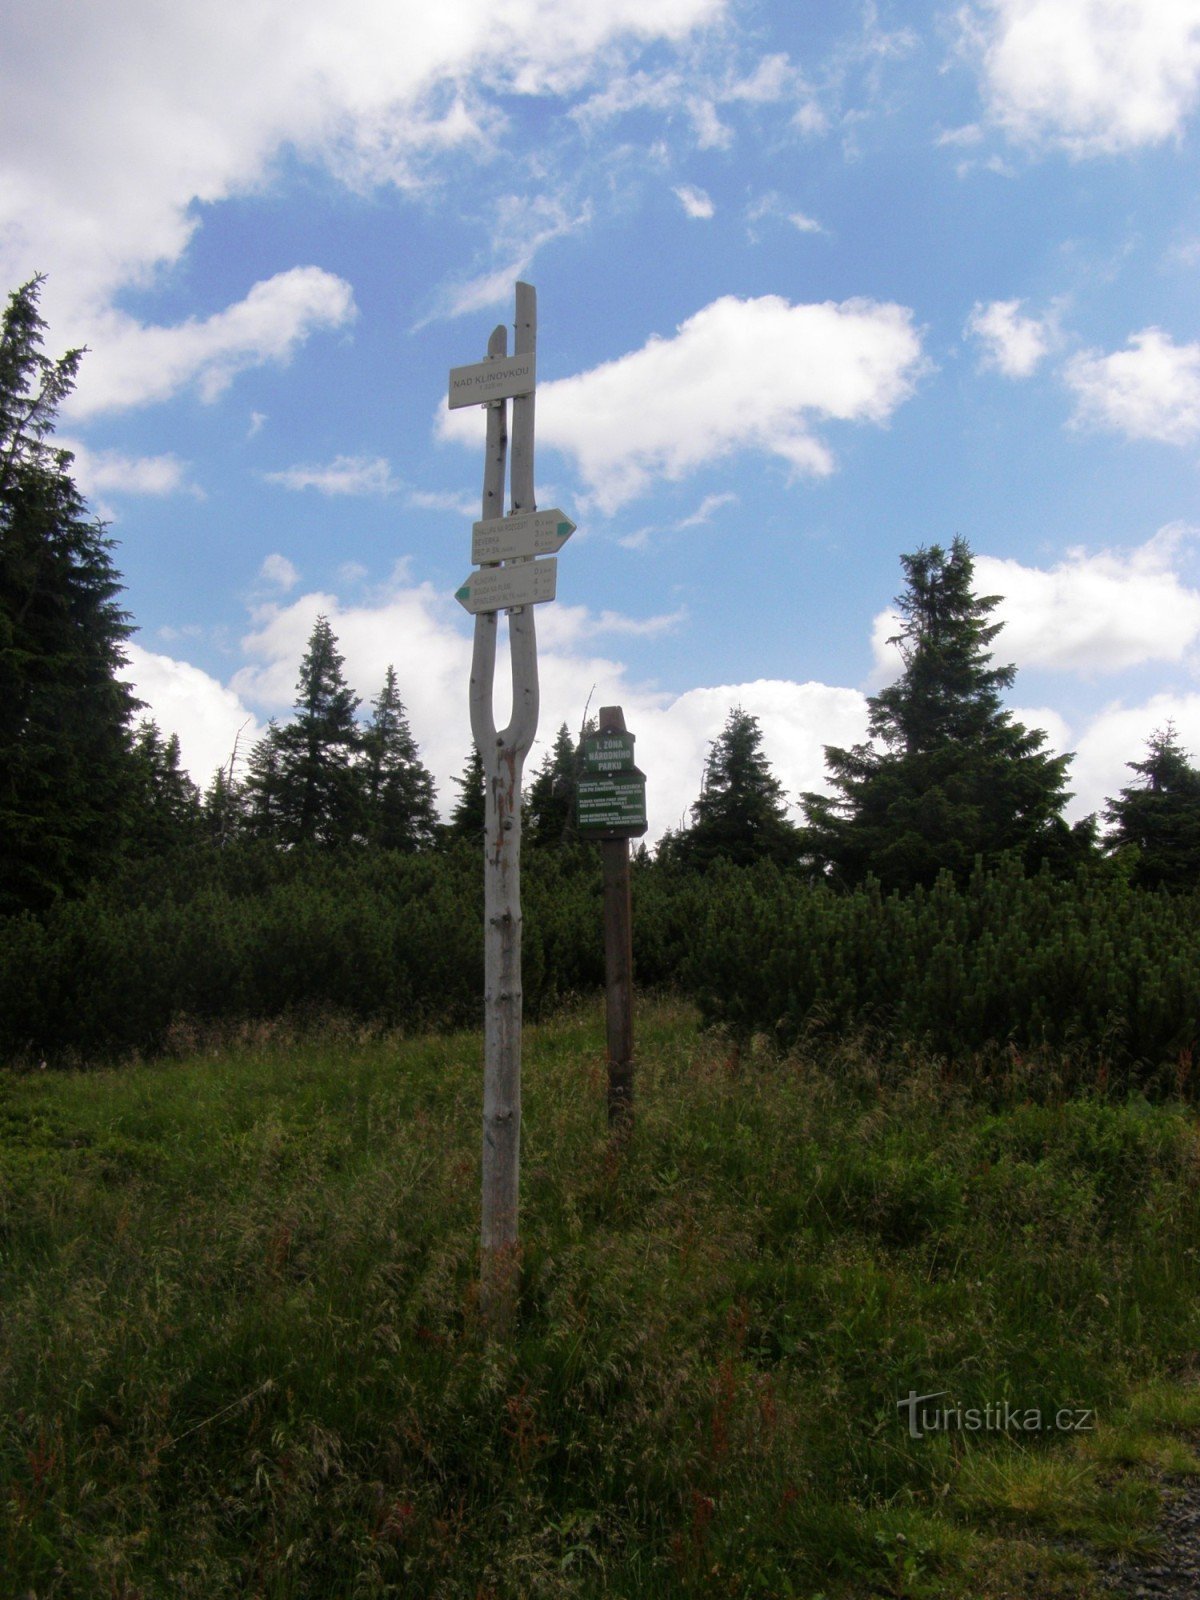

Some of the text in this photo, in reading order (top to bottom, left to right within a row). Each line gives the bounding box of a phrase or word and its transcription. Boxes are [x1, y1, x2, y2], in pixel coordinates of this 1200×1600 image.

[453, 377, 473, 388] NAD
[604, 740, 623, 749] ZÓNA
[588, 750, 631, 761] NÁRODNÍHO
[598, 761, 622, 771] PARKU
